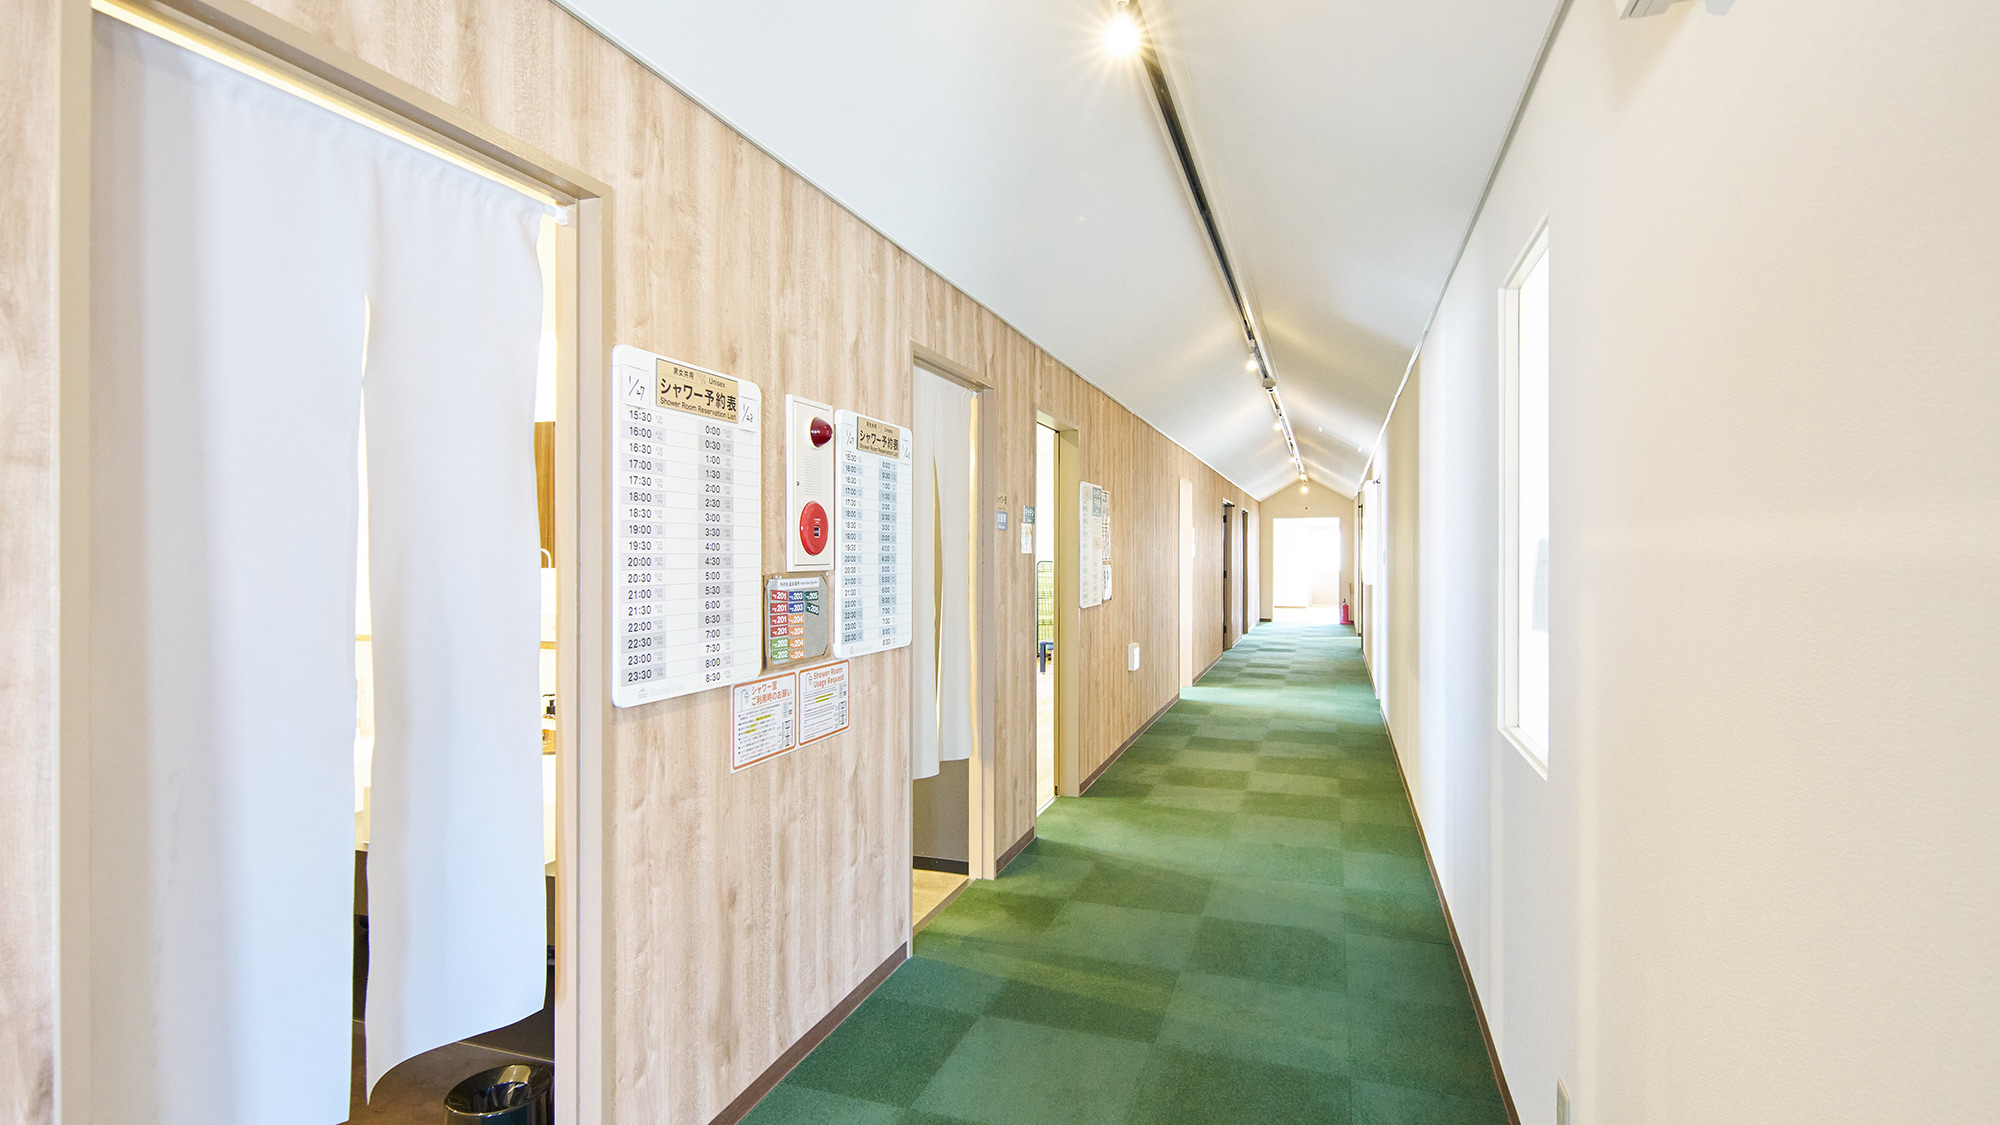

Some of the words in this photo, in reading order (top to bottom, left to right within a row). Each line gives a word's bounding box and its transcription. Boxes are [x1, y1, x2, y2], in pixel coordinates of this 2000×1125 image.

[708, 378, 726, 388] Unisex
[660, 378, 737, 412] シャワー予約表
[660, 397, 681, 408] Shower
[681, 402, 697, 411] Room
[698, 406, 727, 418] Reservation
[727, 412, 737, 420] List
[629, 409, 652, 422] 15:30
[629, 426, 652, 438] 16:00
[705, 424, 721, 436] 0:00
[705, 439, 721, 450] 0:30
[859, 430, 899, 451] シャワー予約表
[629, 442, 652, 454] 16:30
[629, 458, 652, 470] 17:00
[705, 454, 721, 464] 1:00
[705, 469, 721, 479] 1:30
[629, 475, 652, 486] 17:30
[705, 483, 721, 493] 2:00
[629, 491, 652, 502] 18:00
[705, 498, 721, 508] 2:30
[629, 507, 652, 518] 18:30
[705, 512, 721, 522] 3:00
[629, 524, 652, 534] 19:00
[705, 527, 721, 536] 3:30
[629, 540, 652, 550] 19:30
[705, 542, 721, 551] 4:00
[628, 556, 652, 566] 20:00
[705, 556, 721, 565] 4:30
[628, 572, 652, 583] 20:30
[705, 571, 721, 580] 5:00
[628, 588, 652, 599] 21:00
[705, 585, 721, 595] 5:30
[705, 599, 721, 609] 6:00
[628, 604, 652, 616] 21:30
[705, 614, 721, 624] 6:30
[628, 620, 652, 632] 22:00
[705, 628, 721, 638] 7:00
[628, 636, 652, 649] 22:30
[705, 642, 721, 653] 7:30
[628, 652, 652, 665] 23:00
[705, 657, 721, 668] 8:00
[628, 668, 652, 682] 23:30
[705, 671, 721, 683] 8:30
[813, 670, 830, 680] Shower
[831, 667, 843, 675] Room
[813, 679, 826, 688] Usage
[827, 674, 844, 685] Request
